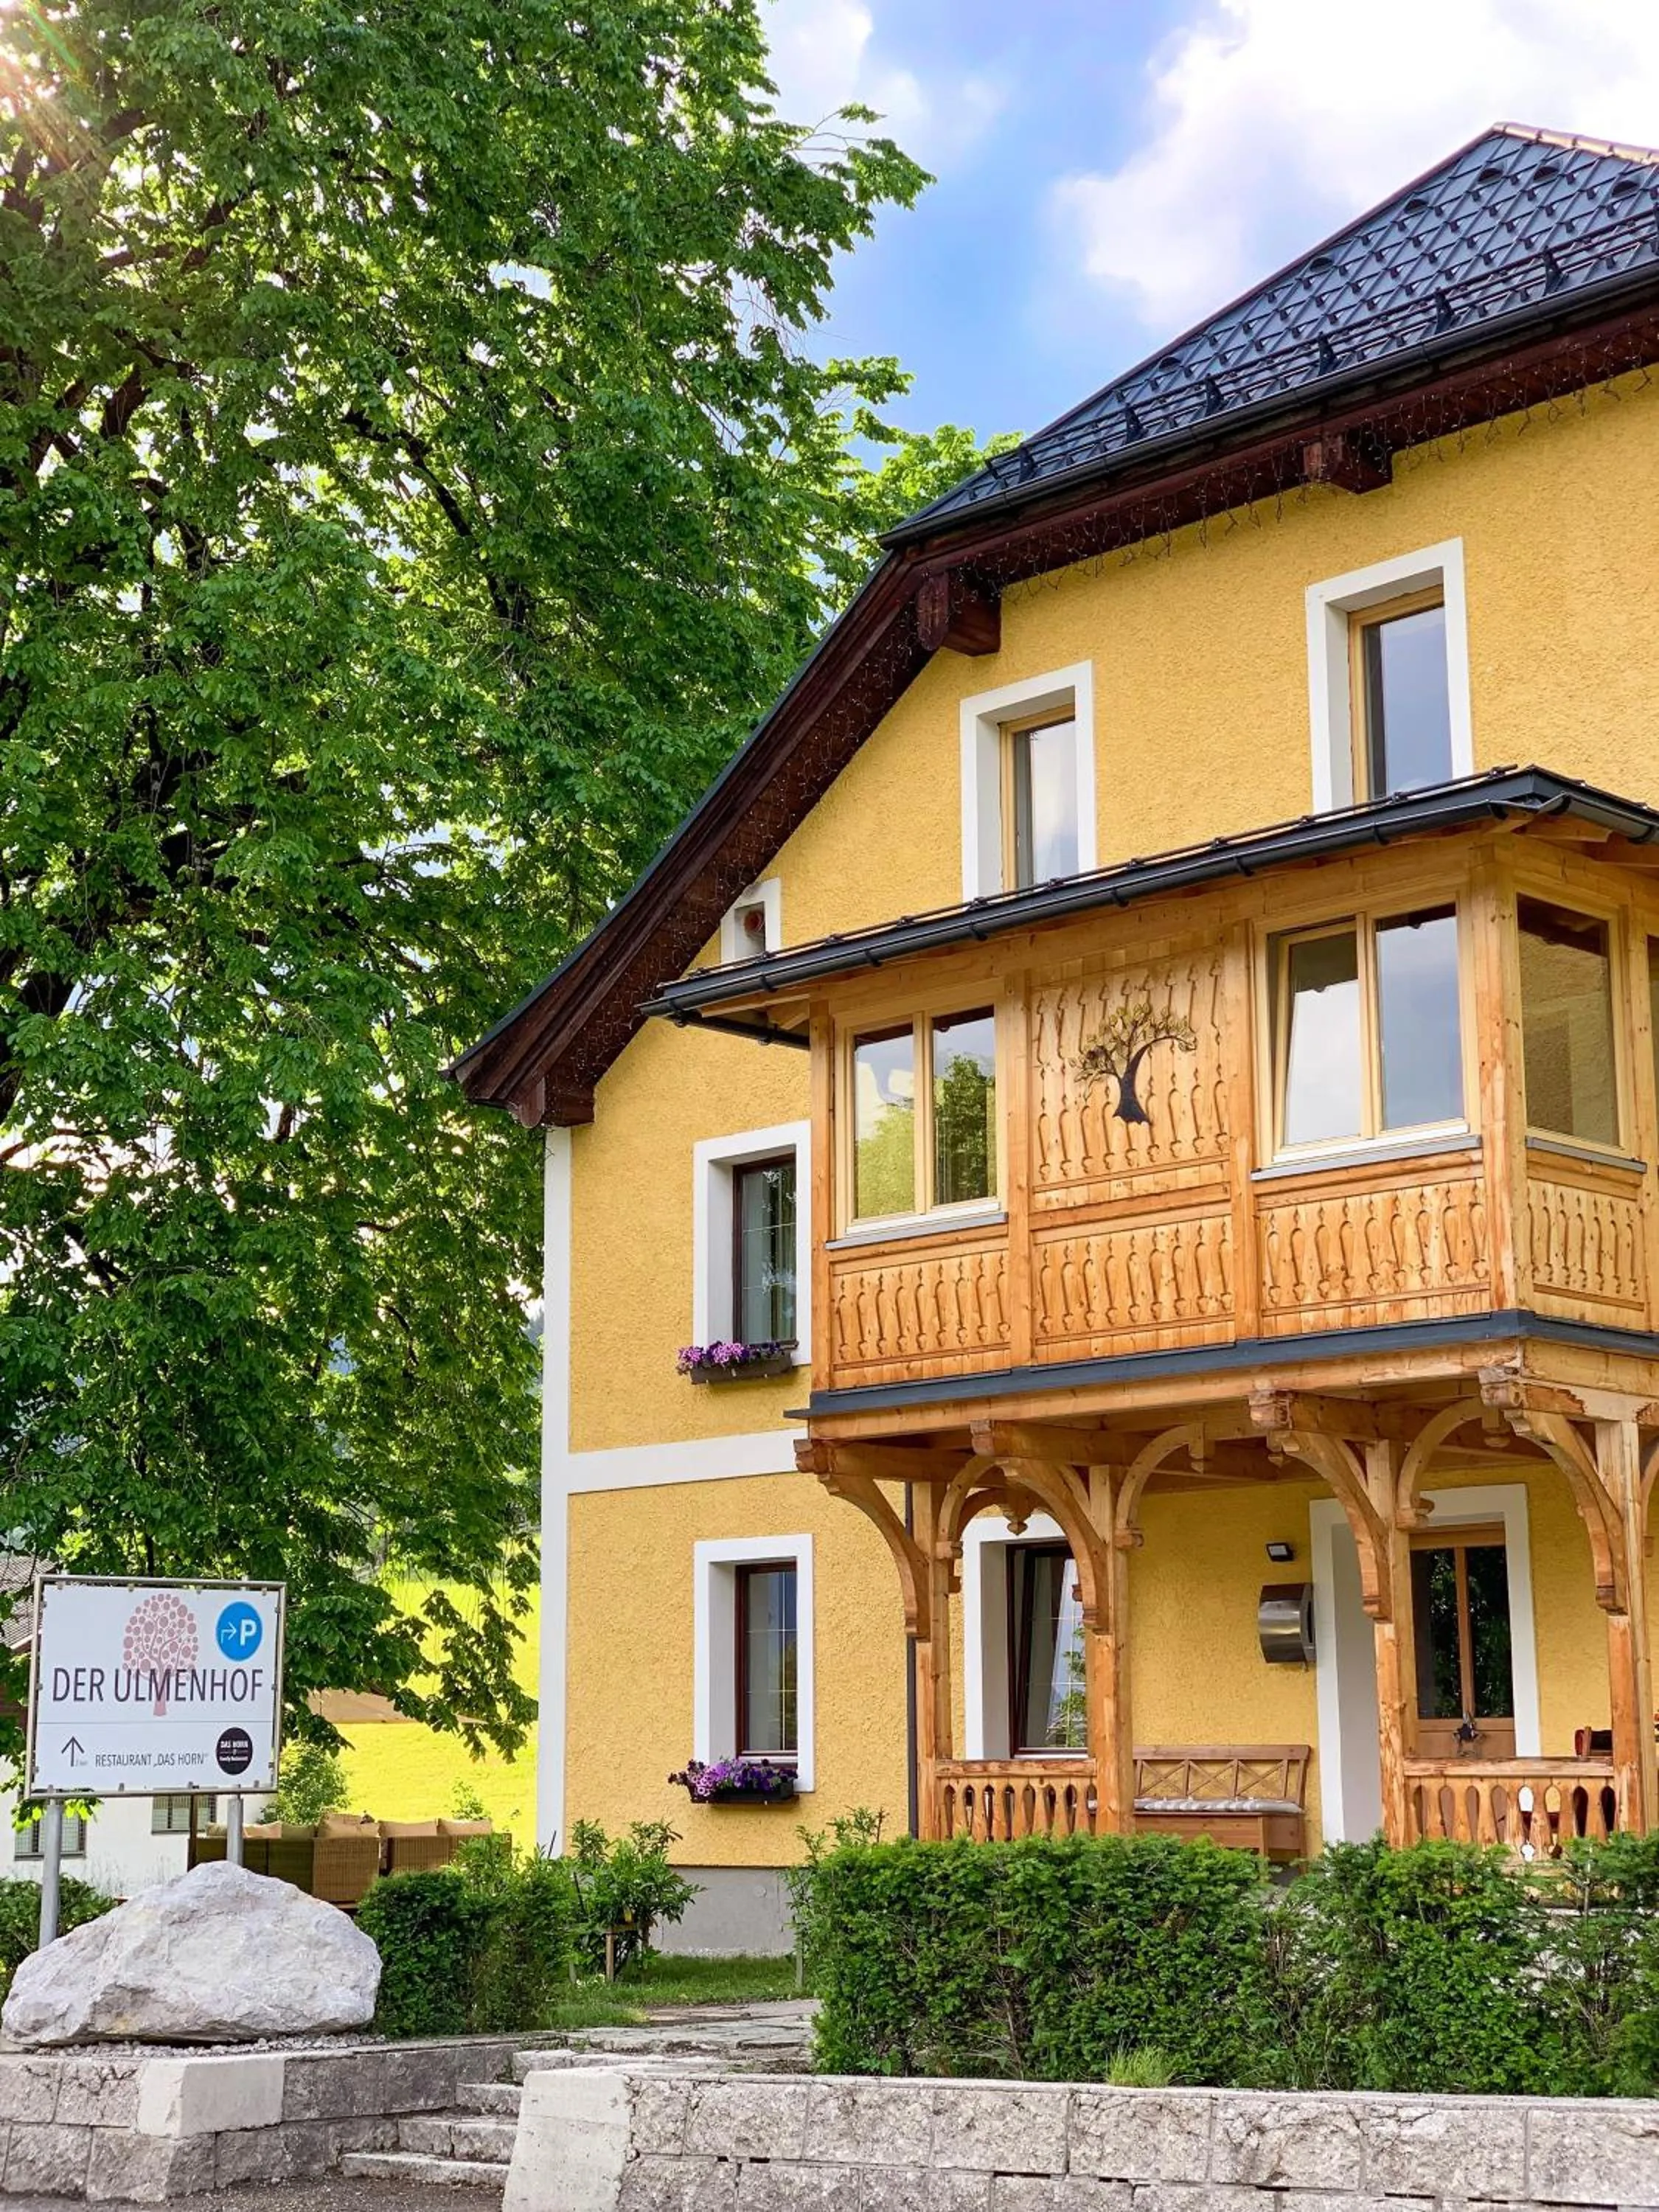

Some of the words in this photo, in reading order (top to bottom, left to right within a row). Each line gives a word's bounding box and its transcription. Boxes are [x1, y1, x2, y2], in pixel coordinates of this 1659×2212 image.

[240, 1619, 257, 1646] P
[52, 1667, 105, 1703] DER
[114, 1667, 263, 1703] ULMENHOF
[95, 1753, 152, 1767] RESTAURANT
